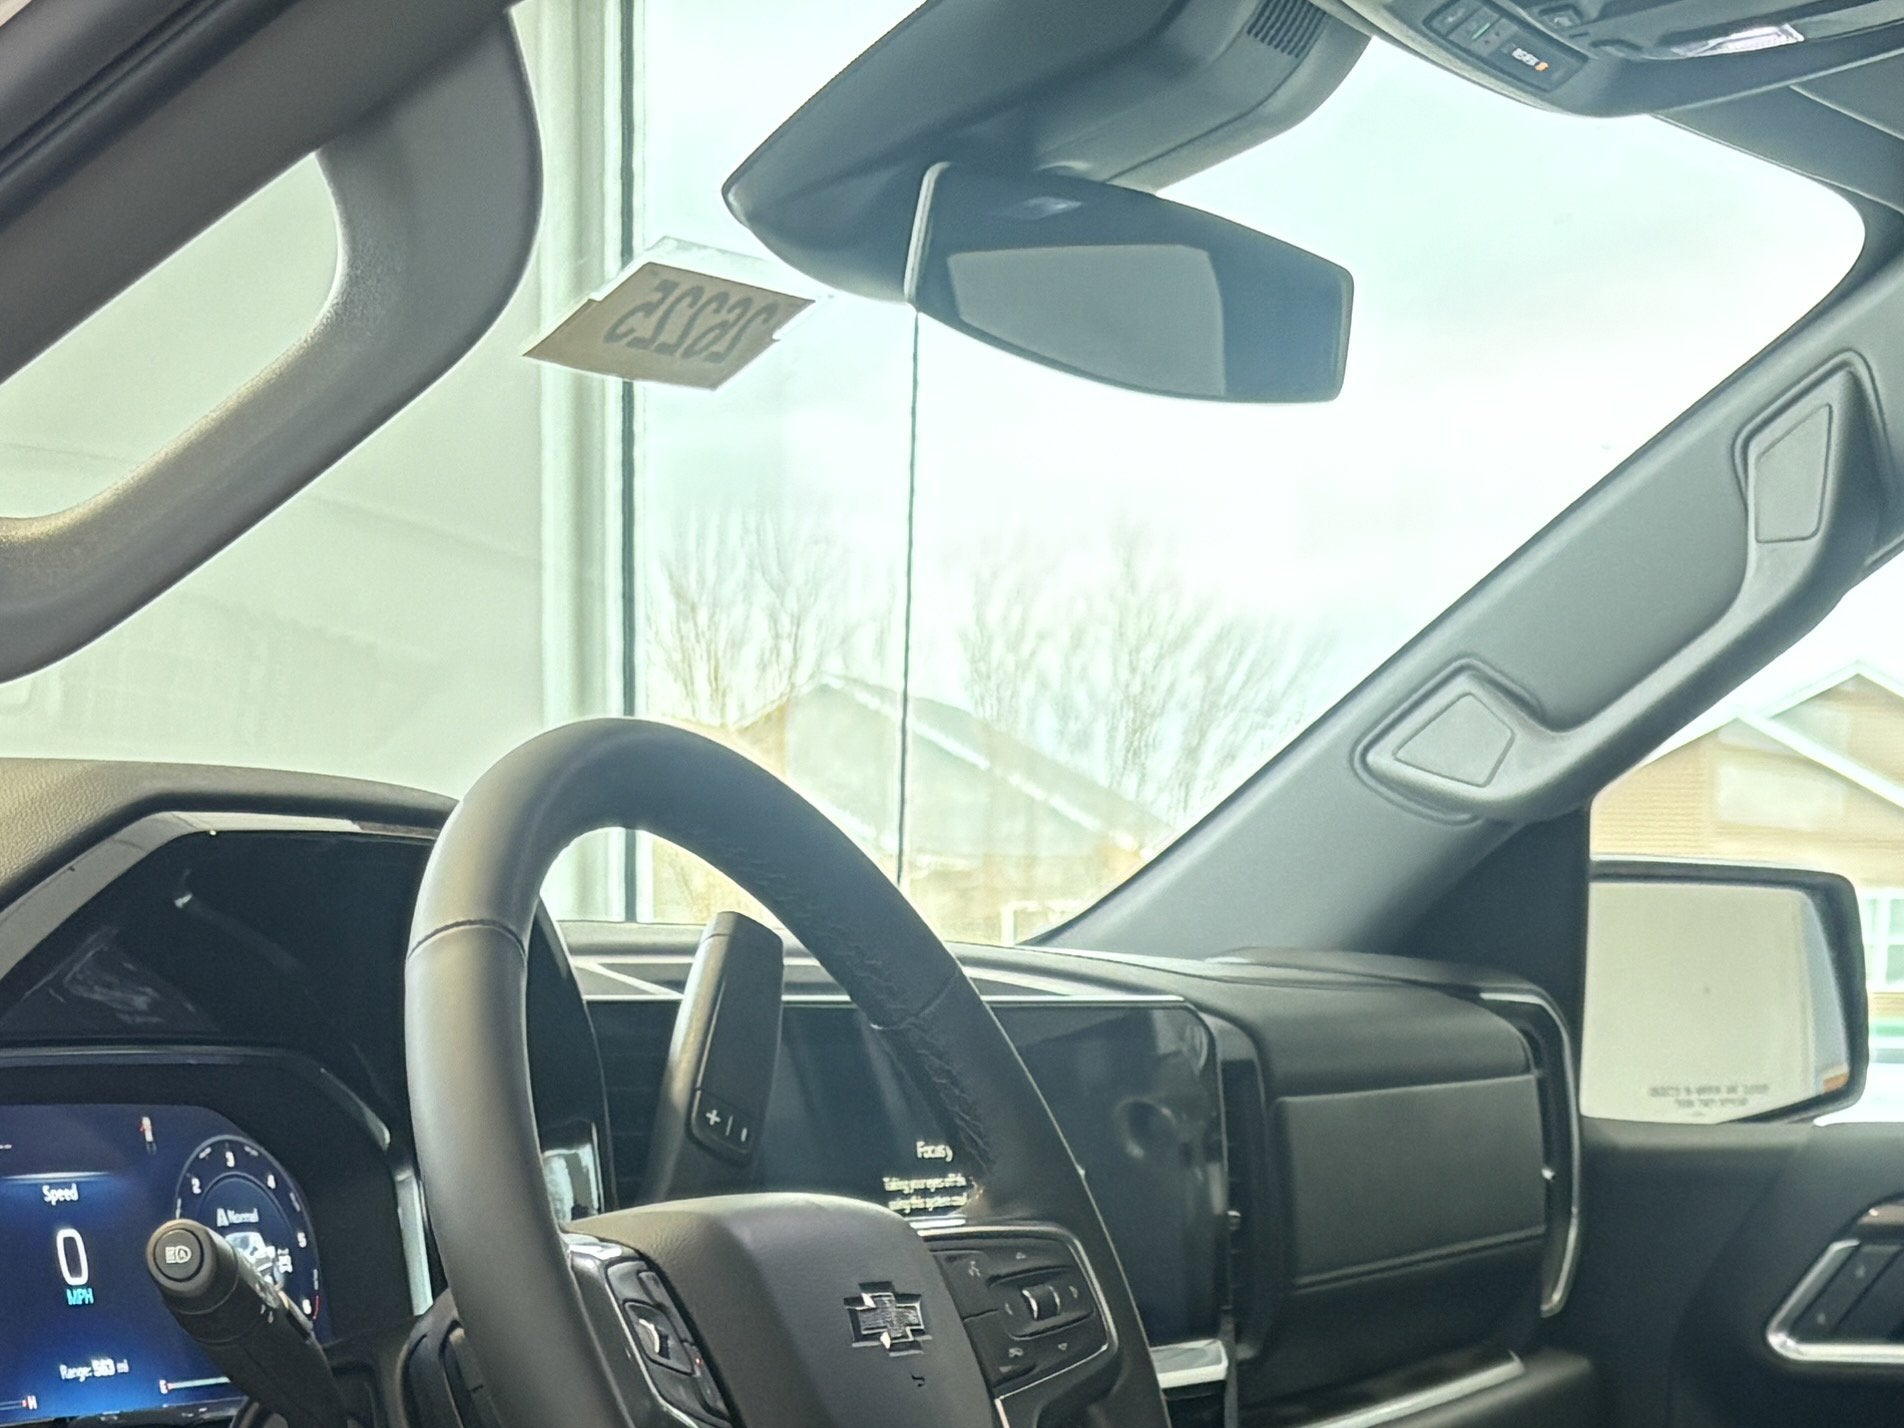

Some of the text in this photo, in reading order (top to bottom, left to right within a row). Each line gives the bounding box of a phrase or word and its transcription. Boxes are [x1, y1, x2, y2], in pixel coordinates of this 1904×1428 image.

[225, 1151, 236, 1168] 3
[191, 1176, 202, 1195] 2
[266, 1174, 277, 1190] 4
[42, 1183, 79, 1206] Speed
[297, 1231, 307, 1248] 5
[56, 1228, 89, 1287] 0
[66, 1287, 95, 1306] MPH
